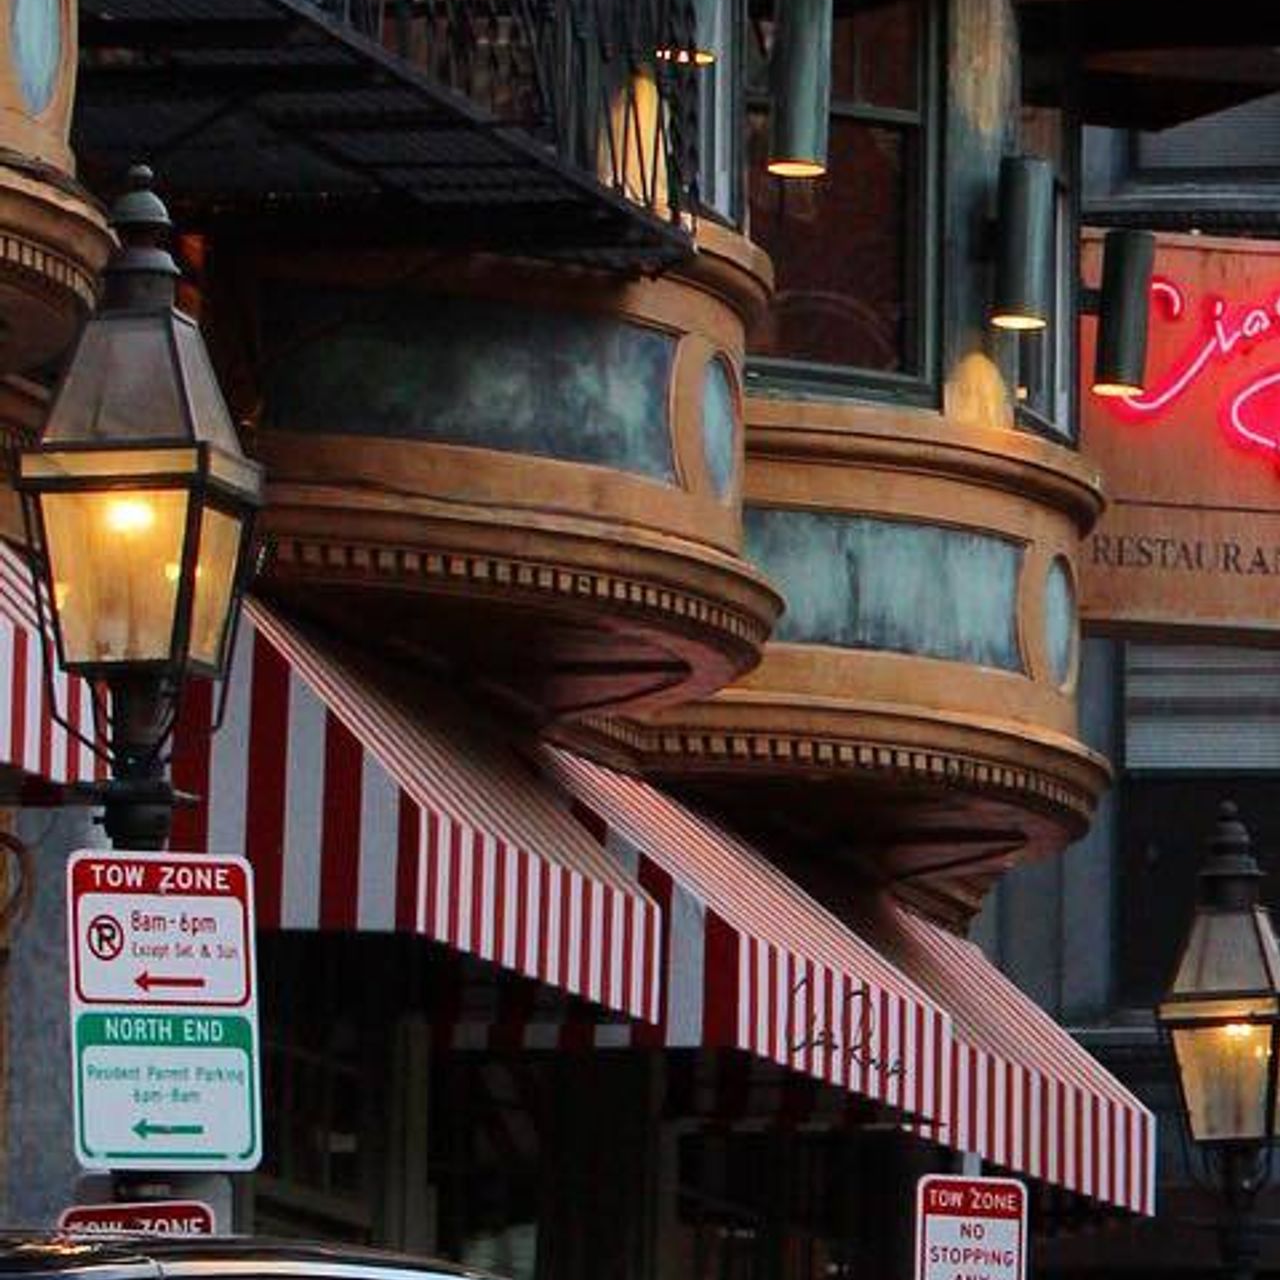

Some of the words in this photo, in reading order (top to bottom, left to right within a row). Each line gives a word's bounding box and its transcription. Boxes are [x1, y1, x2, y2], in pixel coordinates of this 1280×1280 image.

[90, 864, 144, 888] TOW
[159, 866, 231, 890] ZONE
[105, 1019, 172, 1041] NORTH
[184, 1020, 224, 1042] END
[930, 1189, 964, 1208] TOW
[971, 1190, 1018, 1211] ZONE
[960, 1224, 985, 1240] NO
[930, 1246, 1014, 1267] STOPPING
